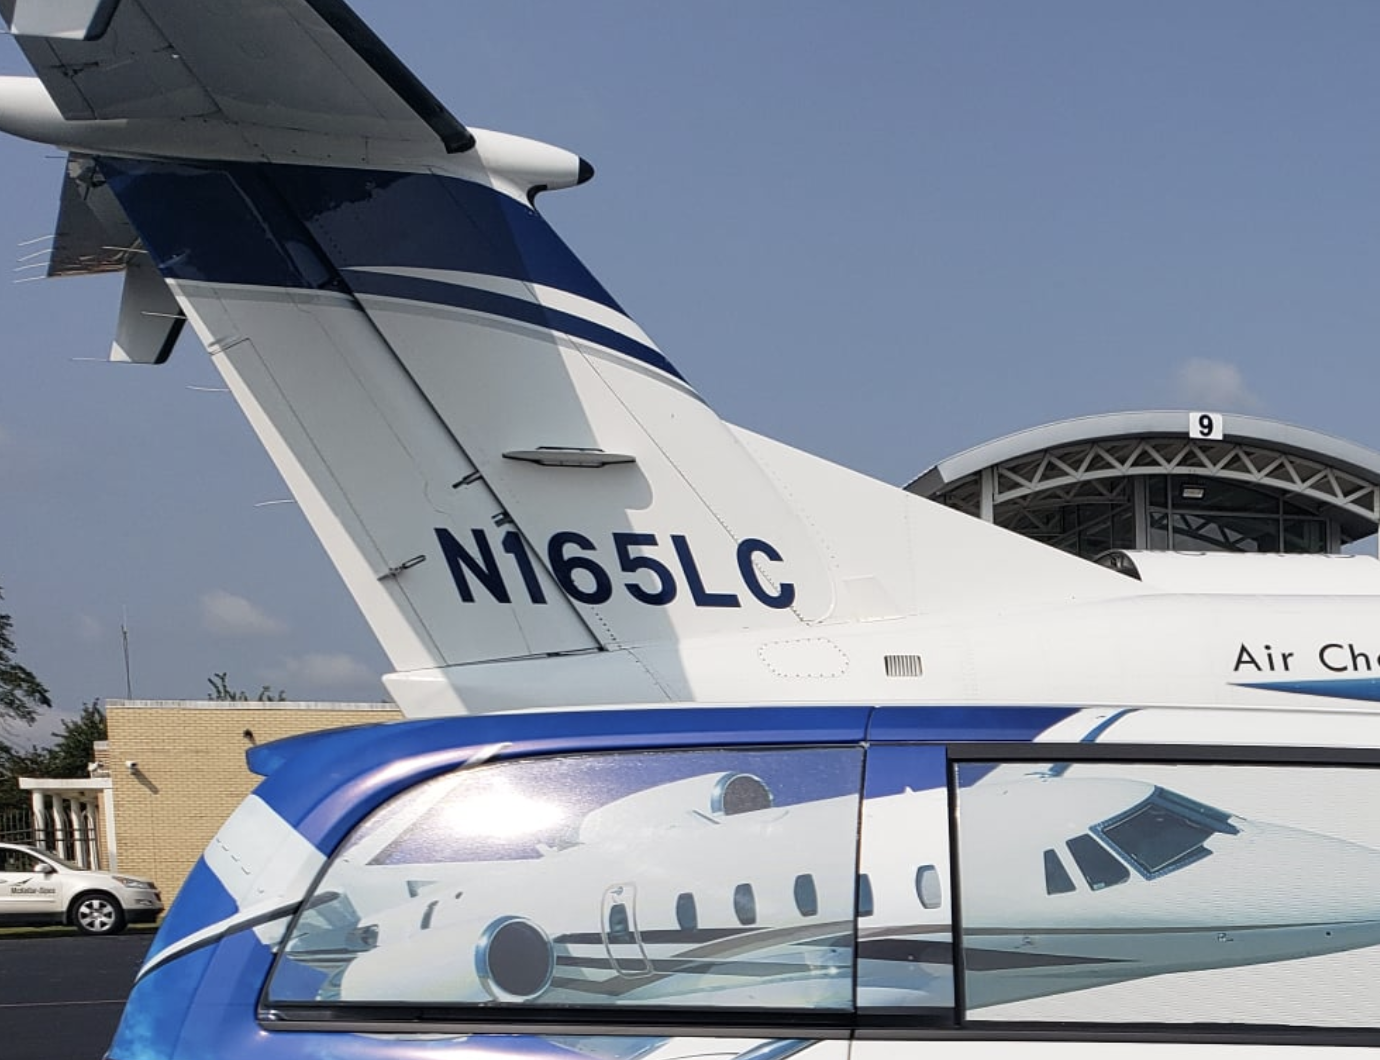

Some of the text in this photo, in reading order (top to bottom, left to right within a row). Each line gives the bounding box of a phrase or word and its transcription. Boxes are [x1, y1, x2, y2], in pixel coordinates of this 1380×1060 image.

[1198, 414, 1213, 437] 9
[434, 527, 796, 609] N165LC
[1233, 643, 1295, 672] Air
